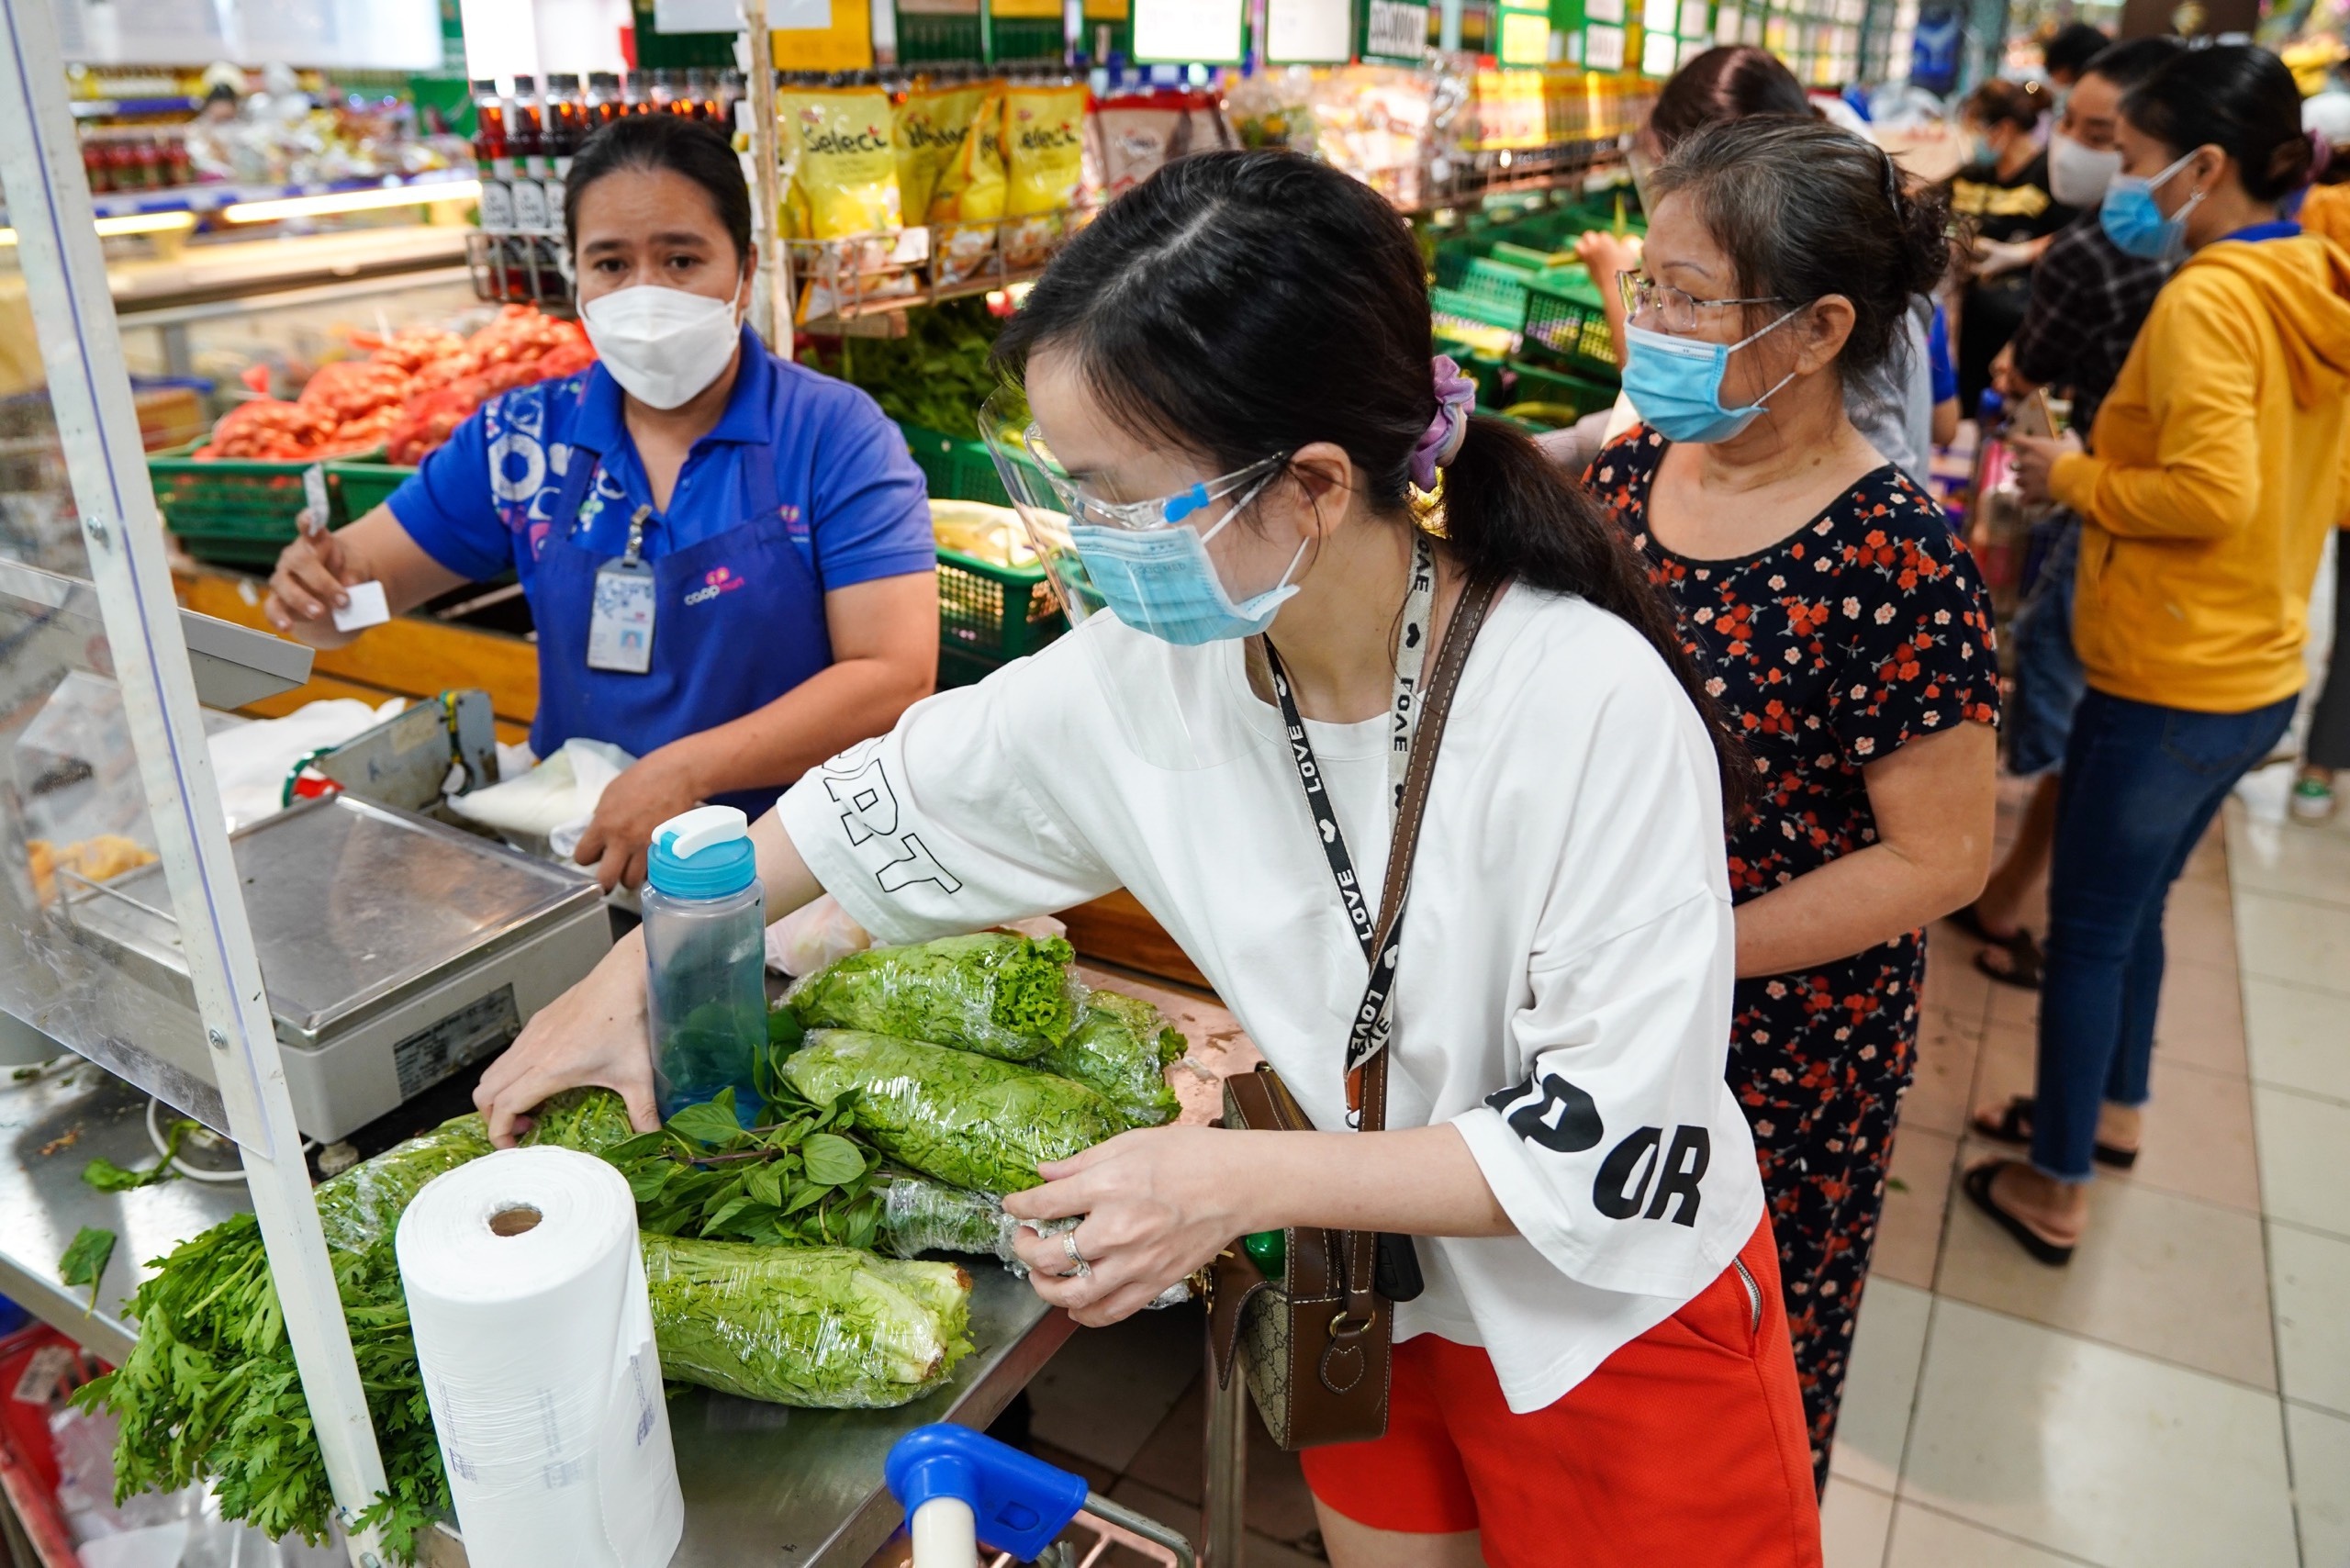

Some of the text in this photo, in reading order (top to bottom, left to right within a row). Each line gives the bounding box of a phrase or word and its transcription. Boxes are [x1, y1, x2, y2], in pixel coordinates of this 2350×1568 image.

[801, 125, 888, 155] Select
[1287, 724, 1373, 941] LOVE LOVE
[1351, 989, 1383, 1050] LOVE
